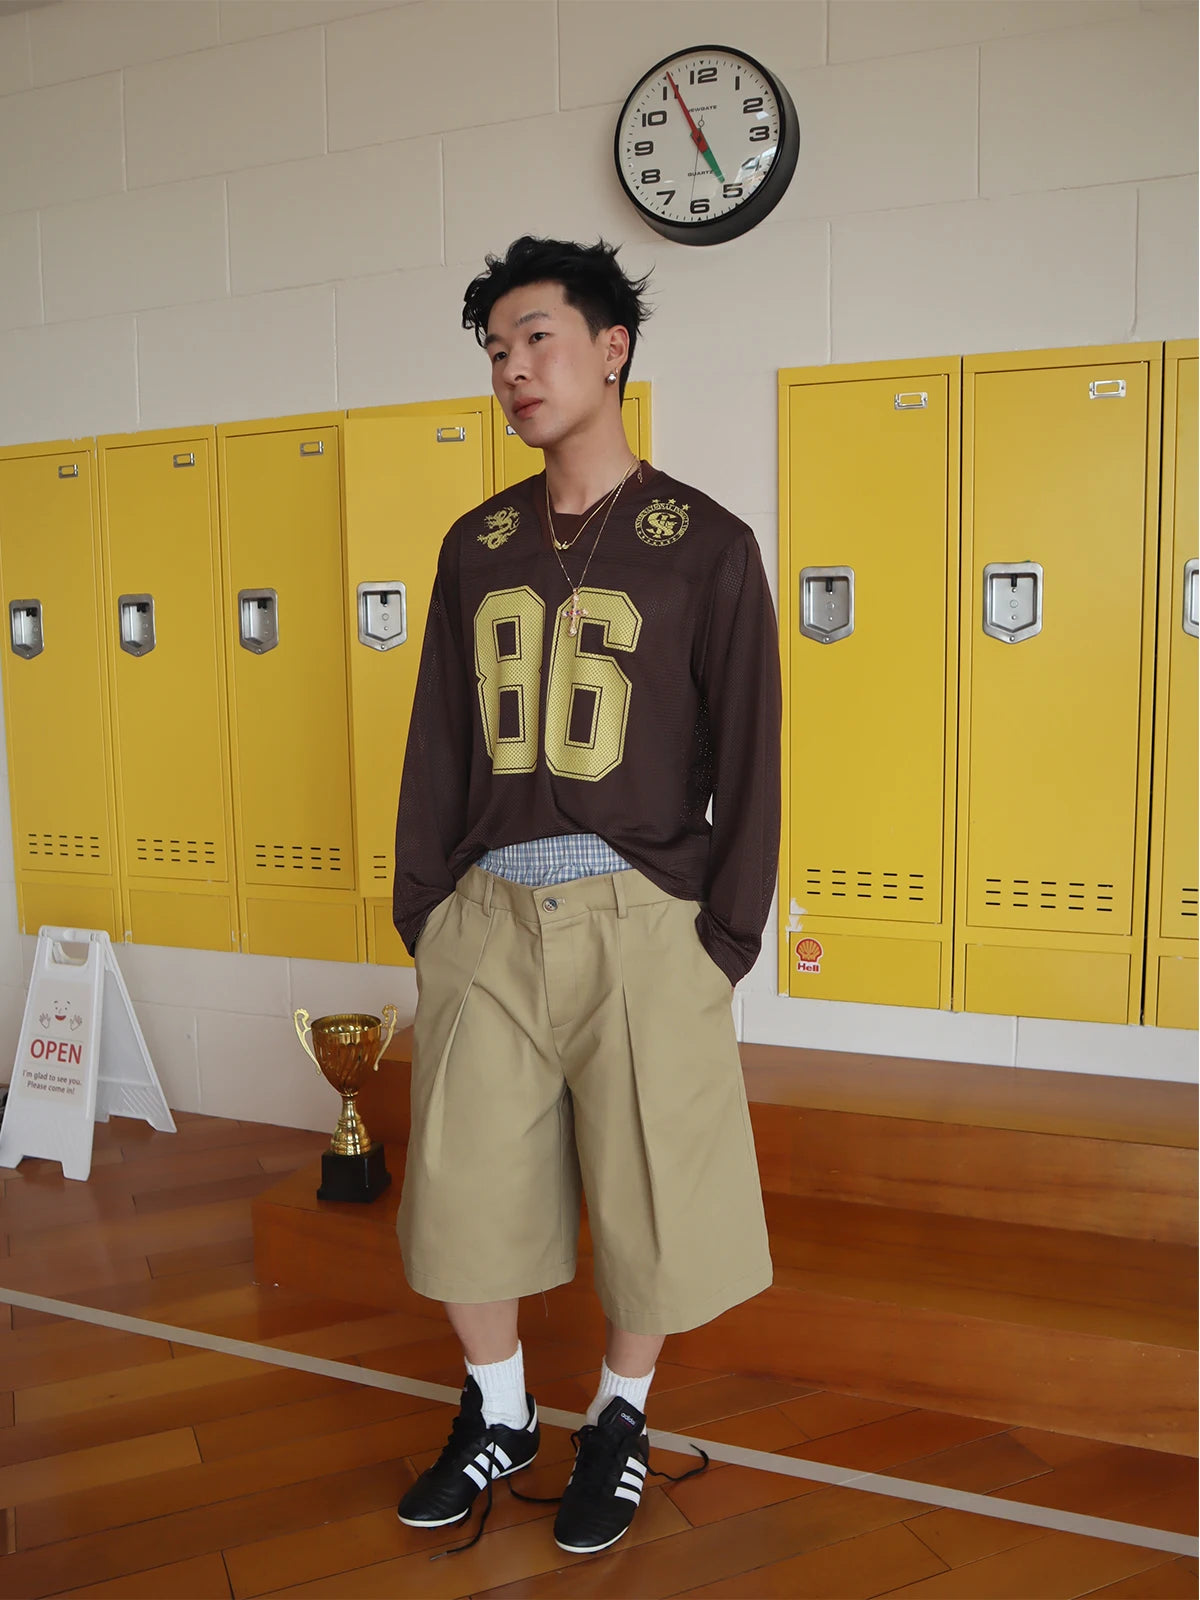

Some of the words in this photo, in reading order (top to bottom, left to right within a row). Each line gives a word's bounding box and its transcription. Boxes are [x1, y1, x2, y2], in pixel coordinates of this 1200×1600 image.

[689, 67, 717, 85] 12
[735, 76, 740, 91] 1
[743, 97, 764, 114] 2
[641, 110, 667, 127] 10
[749, 125, 770, 142] 3
[634, 140, 654, 156] 9
[641, 168, 661, 185] 8
[656, 190, 675, 206] 7
[722, 182, 743, 199] 5
[689, 198, 710, 214] 6
[473, 584, 643, 782] 86
[798, 963, 819, 972] Hell
[31, 1039, 82, 1064] OPEN
[23, 1069, 32, 1077] I'm
[33, 1071, 48, 1081] glad
[27, 1081, 47, 1090] Please
[48, 1085, 65, 1093] come
[66, 1087, 75, 1095] in!
